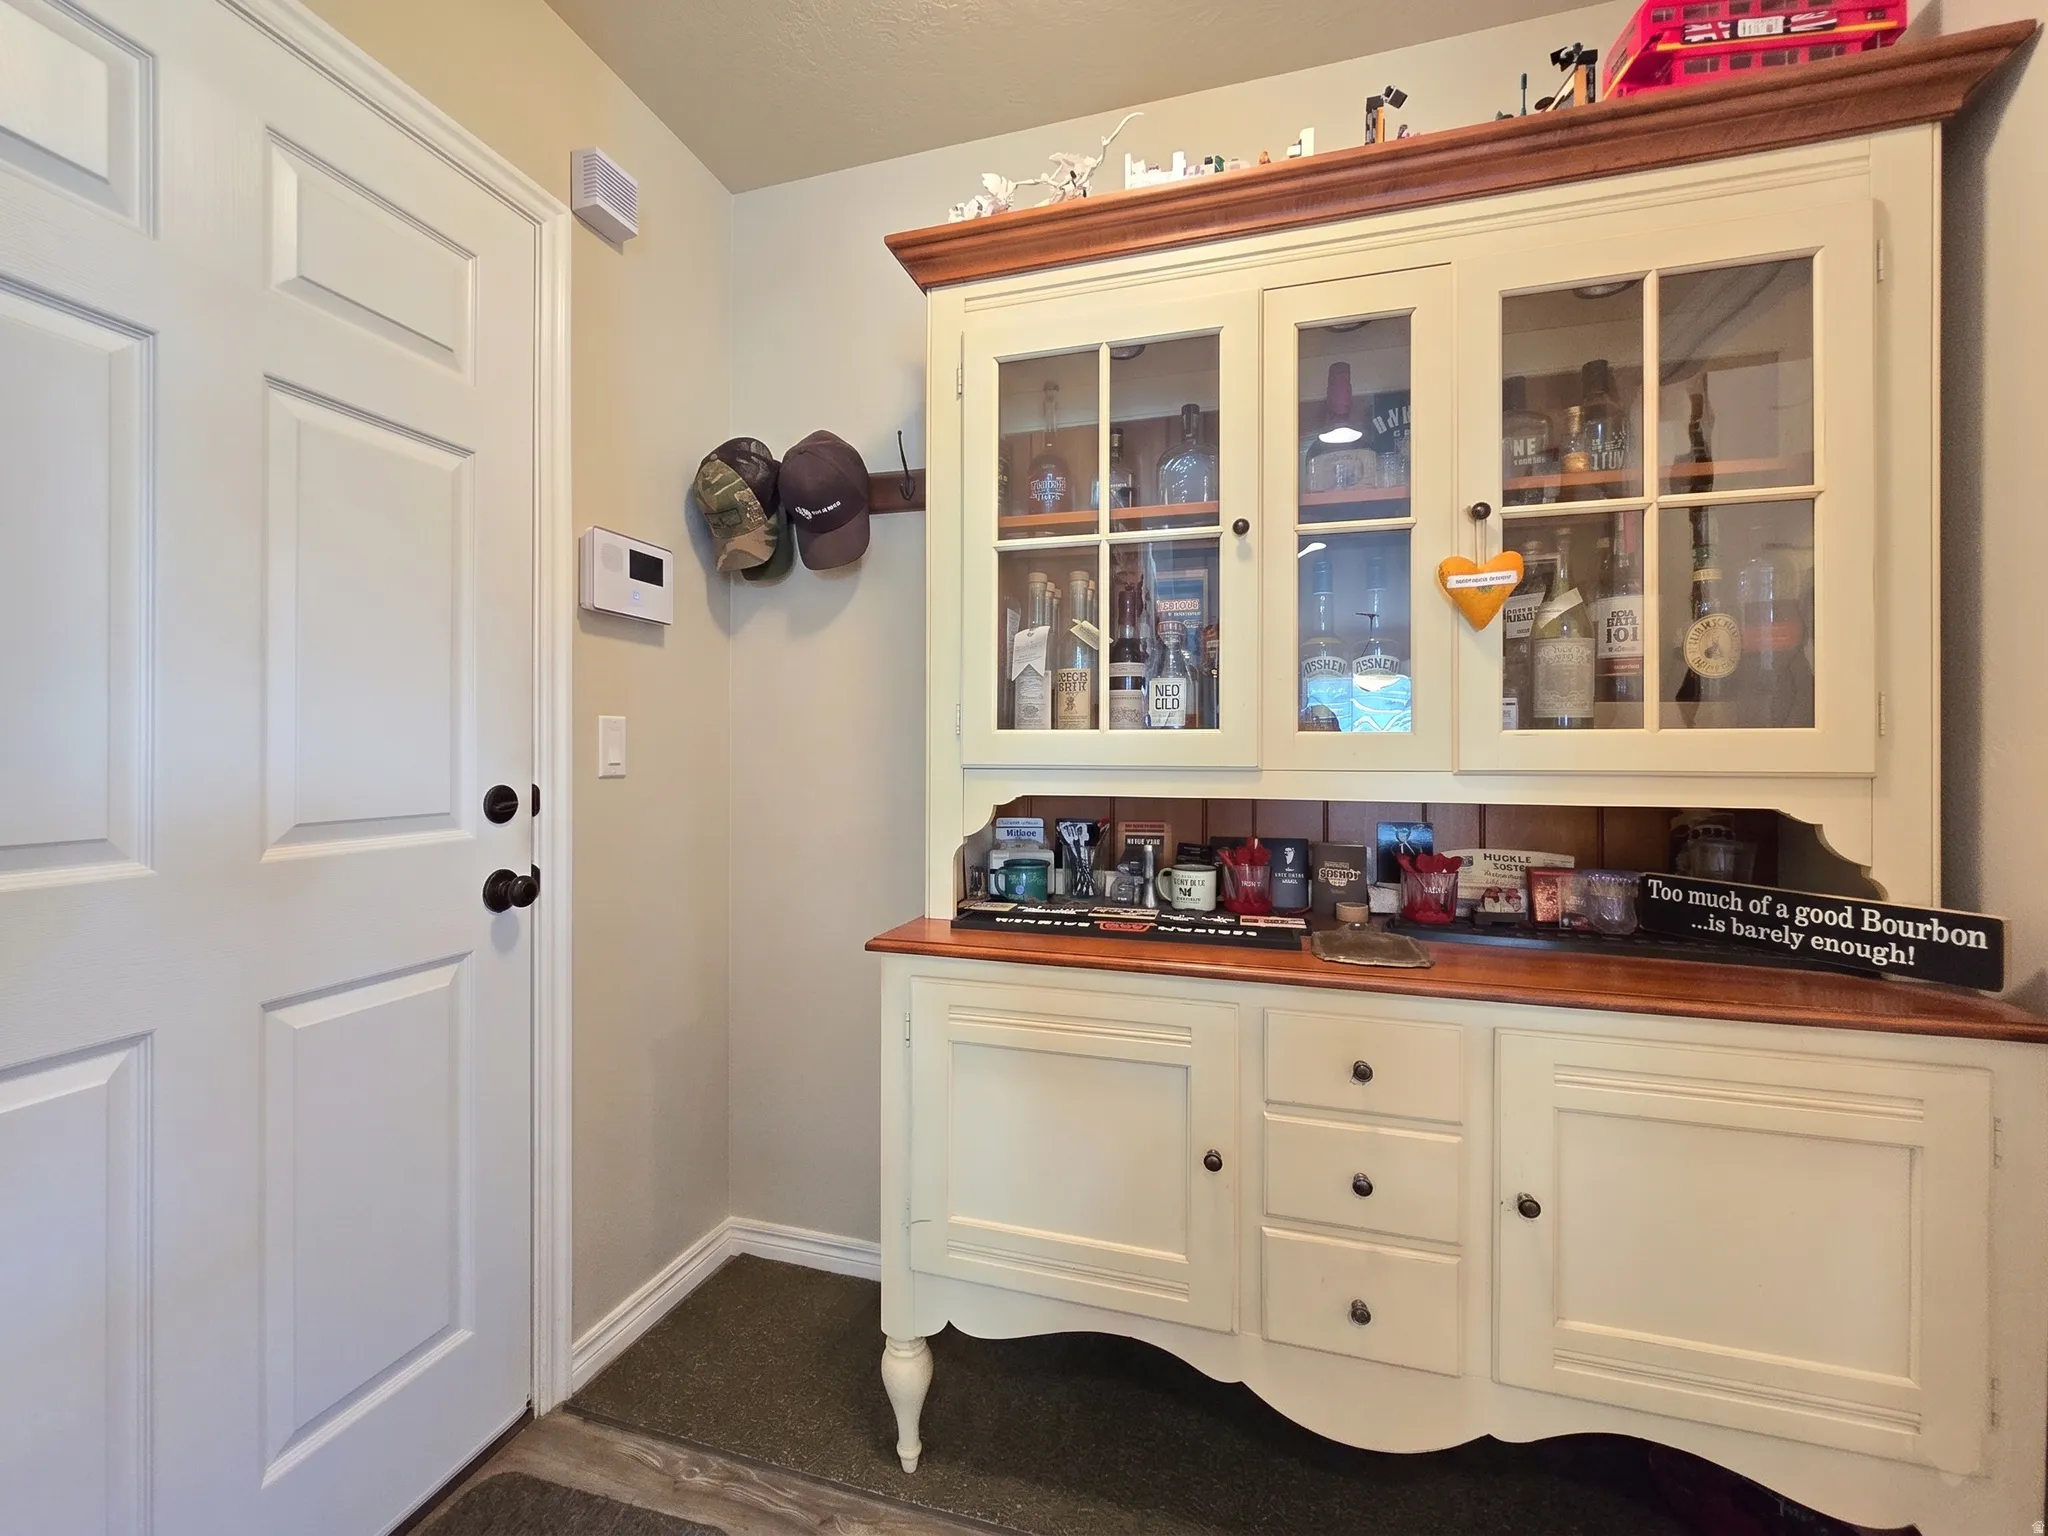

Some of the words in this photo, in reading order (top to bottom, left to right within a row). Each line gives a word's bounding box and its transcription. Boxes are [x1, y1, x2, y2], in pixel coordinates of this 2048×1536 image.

[1606, 626, 1640, 644] 101
[1483, 853, 1532, 864] HUCKLE
[1647, 879, 1683, 903] Too
[1688, 889, 1744, 912] much
[1749, 895, 1772, 915] of
[1776, 903, 1790, 919] a
[1794, 904, 1855, 930] good
[1860, 907, 1989, 950] Bourbon
[1690, 913, 1726, 933] ...is
[1731, 917, 1805, 950] barely
[1810, 935, 1916, 966] enough!
